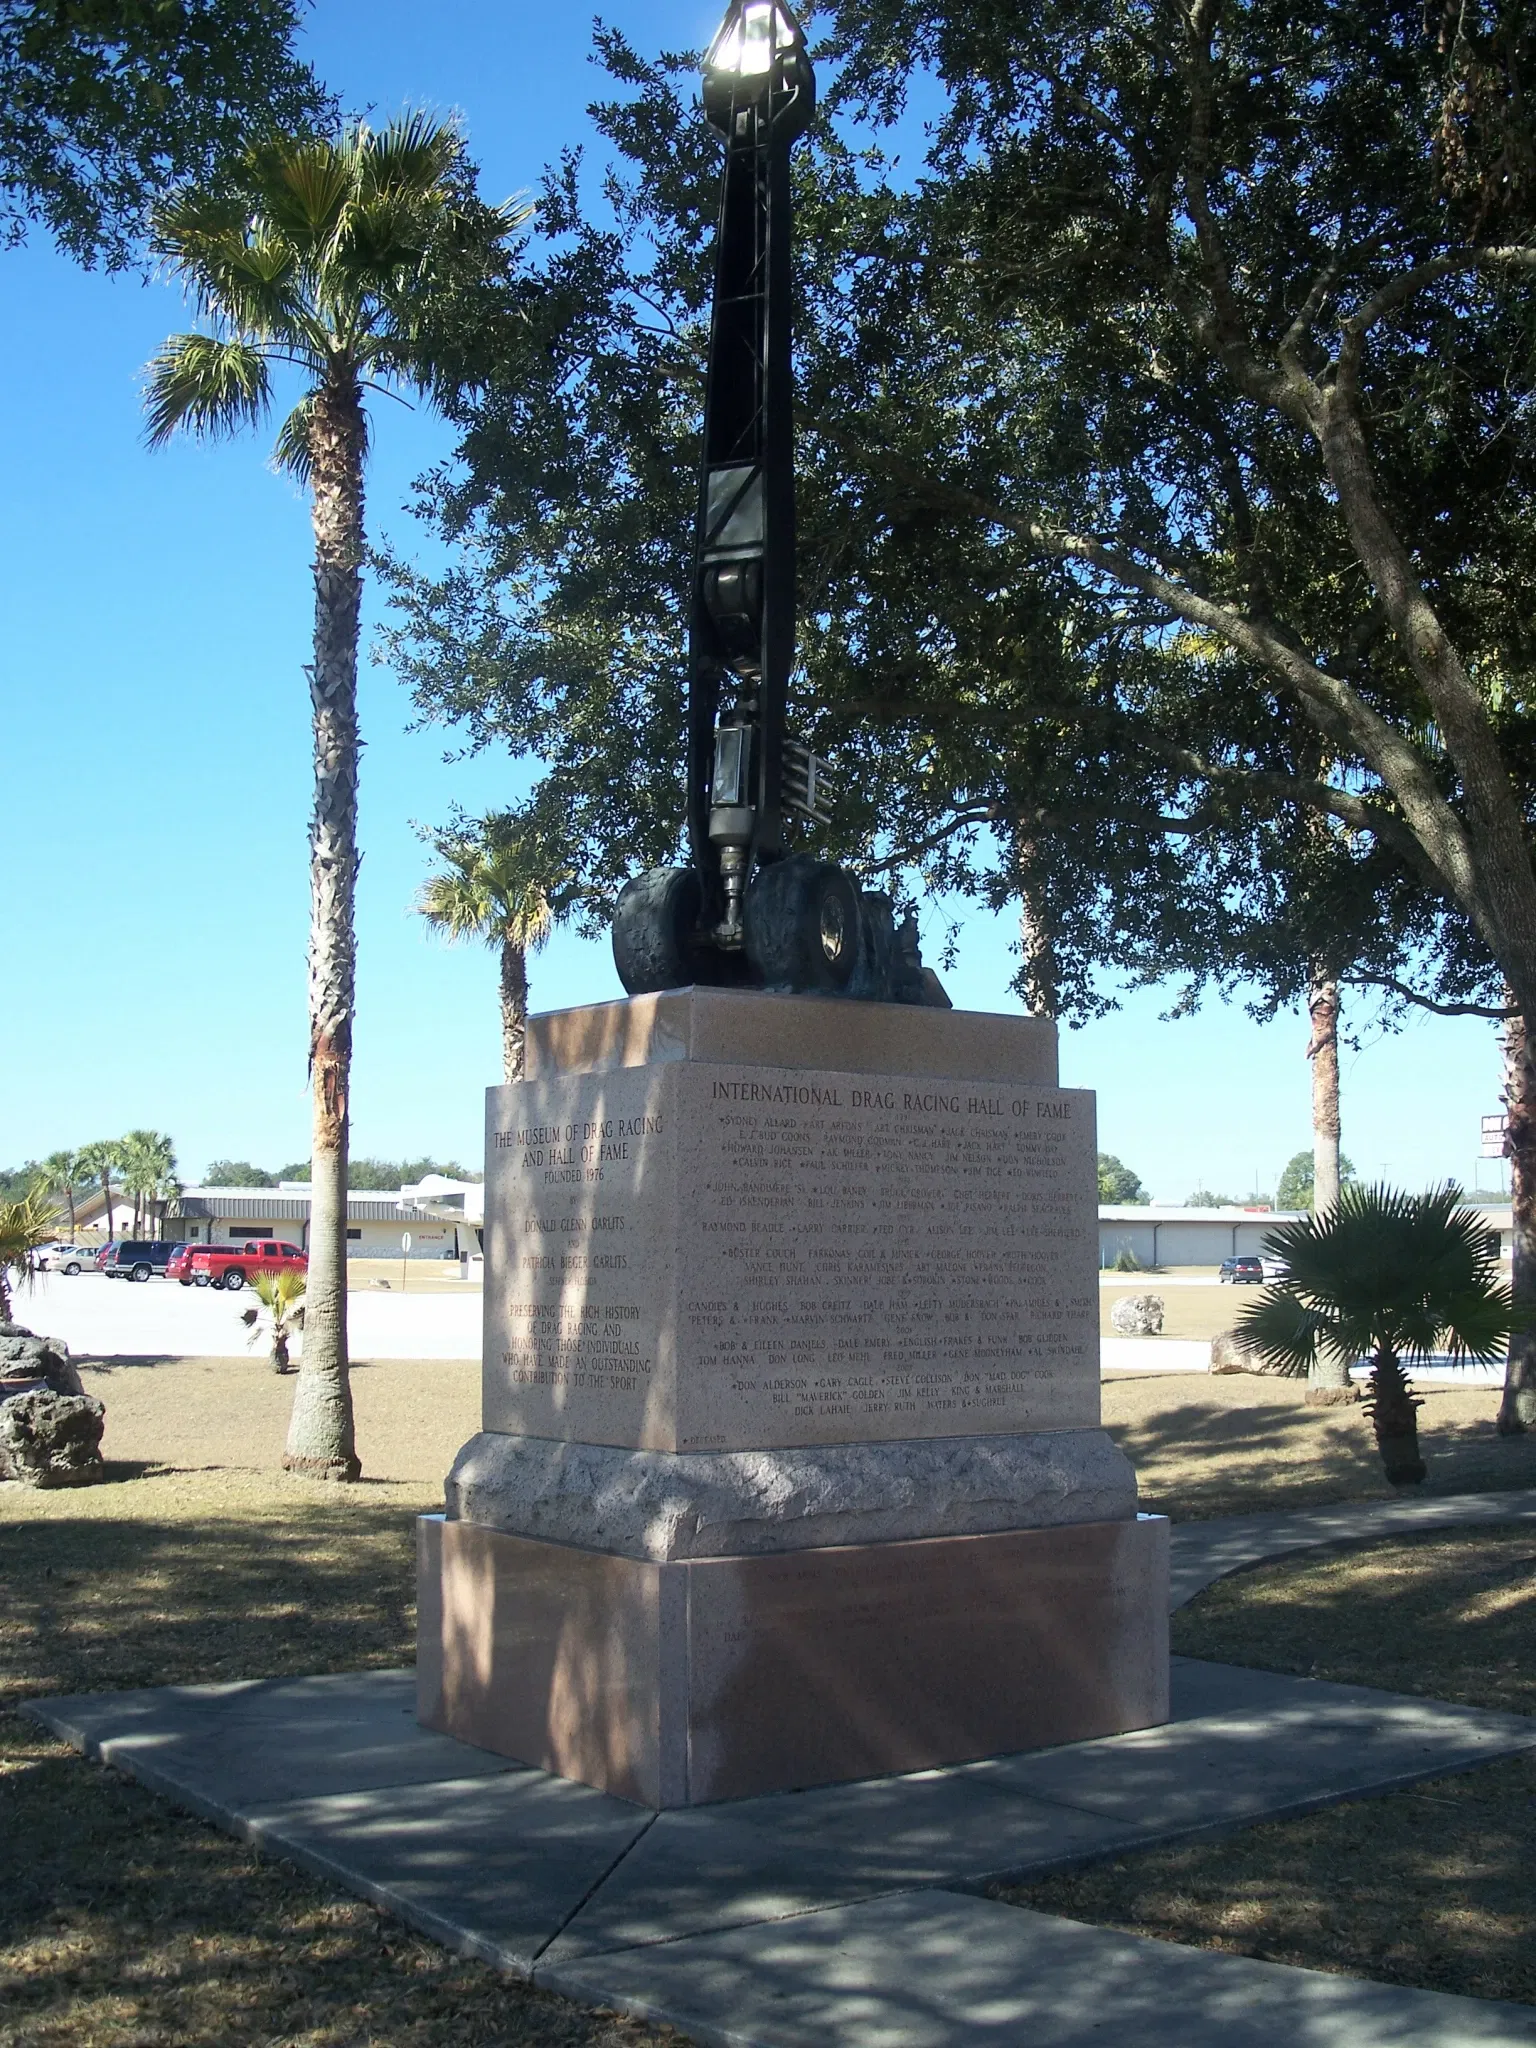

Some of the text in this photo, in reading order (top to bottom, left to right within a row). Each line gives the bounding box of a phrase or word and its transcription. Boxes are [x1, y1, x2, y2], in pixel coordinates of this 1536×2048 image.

[712, 1082, 1072, 1119] INTERNATIONAL DRAG RACING HALL OF FAME
[764, 1118, 797, 1128] ALLARD
[494, 1116, 664, 1148] THE MUSEUM OF DRAG RACING
[522, 1142, 628, 1168] AND HALL OF FAME
[768, 1145, 813, 1156] JOHANSEN
[544, 1168, 604, 1184] FOUNDED 1976
[525, 1216, 625, 1232] DONALD GLENN GARLITS
[522, 1254, 628, 1270] PATRICIA BIEGER GARLITS
[744, 1276, 779, 1286] SHIRLEY
[786, 1276, 822, 1286] SHAHAN
[509, 1304, 641, 1320] PRESERVING THE RICH HISTORY
[688, 1302, 727, 1312] CANDIES
[752, 1302, 788, 1311] HUGHES
[800, 1301, 817, 1310] BOB
[691, 1315, 723, 1325] PETERS
[750, 1315, 778, 1324] FRANK
[792, 1314, 825, 1324] MARVIN
[528, 1321, 621, 1336] OF DRAG RACING AND
[512, 1337, 640, 1356] HONORING THOSE INDIVIDUALS
[719, 1341, 736, 1351] BOB
[754, 1340, 784, 1350] EILEEN
[838, 1339, 859, 1348] DALE
[903, 1336, 936, 1346] ENGLISH
[502, 1352, 651, 1374] WHO HAVE MADE AN OUTSTANDING
[700, 1356, 717, 1365] TOM
[723, 1355, 755, 1364] HANNA
[768, 1354, 786, 1364] DON
[792, 1354, 815, 1364] LONG
[513, 1370, 637, 1390] CONTRIBUTION TO THE SPORT
[738, 1380, 756, 1390] DON
[763, 1380, 806, 1390] ALDERSON
[820, 1378, 841, 1388] GARY
[848, 1377, 874, 1387] CAGLE
[886, 1376, 910, 1385] STEVE
[915, 1374, 952, 1384] COLLISON
[772, 1394, 790, 1404] BILL
[796, 1391, 848, 1402] "MAVERICK"
[852, 1390, 885, 1400] GOLDEN
[897, 1388, 911, 1398] JIM
[916, 1387, 940, 1396] KELLY
[952, 1386, 970, 1396] KING
[794, 1406, 814, 1416] DICK
[820, 1405, 850, 1415] LAHAIE
[864, 1404, 888, 1413] JERRY
[894, 1402, 916, 1412] RUTH
